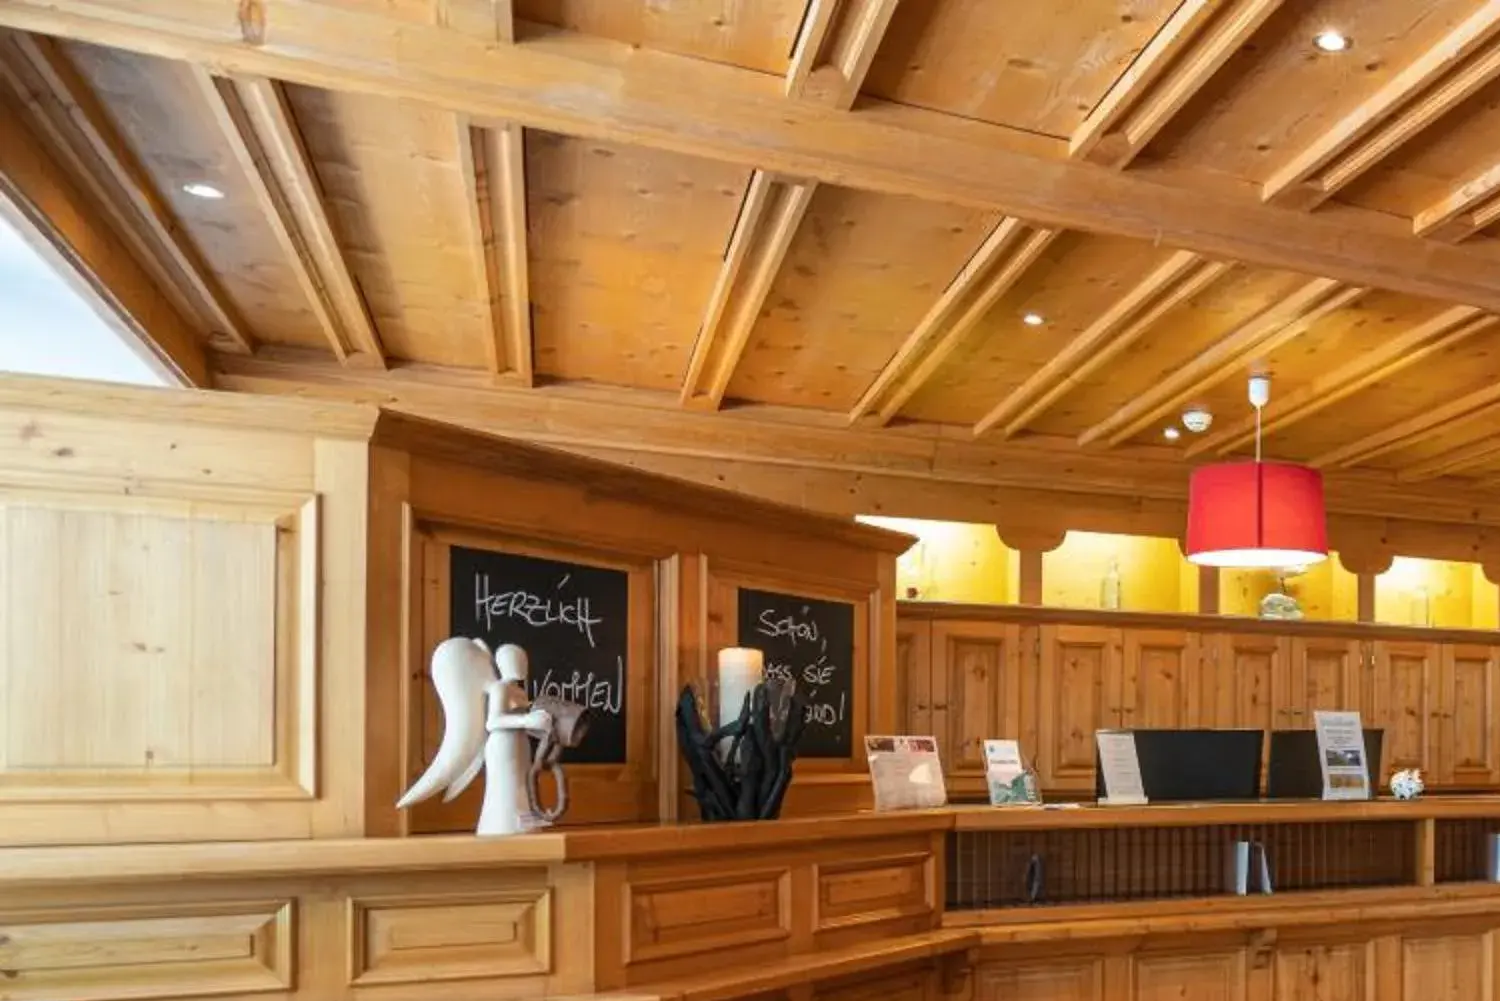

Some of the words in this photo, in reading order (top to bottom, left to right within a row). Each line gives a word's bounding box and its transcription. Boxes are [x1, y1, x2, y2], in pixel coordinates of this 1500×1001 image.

[474, 573, 602, 648] HERZLICH
[765, 663, 794, 681] ASS
[803, 656, 837, 684] SIE
